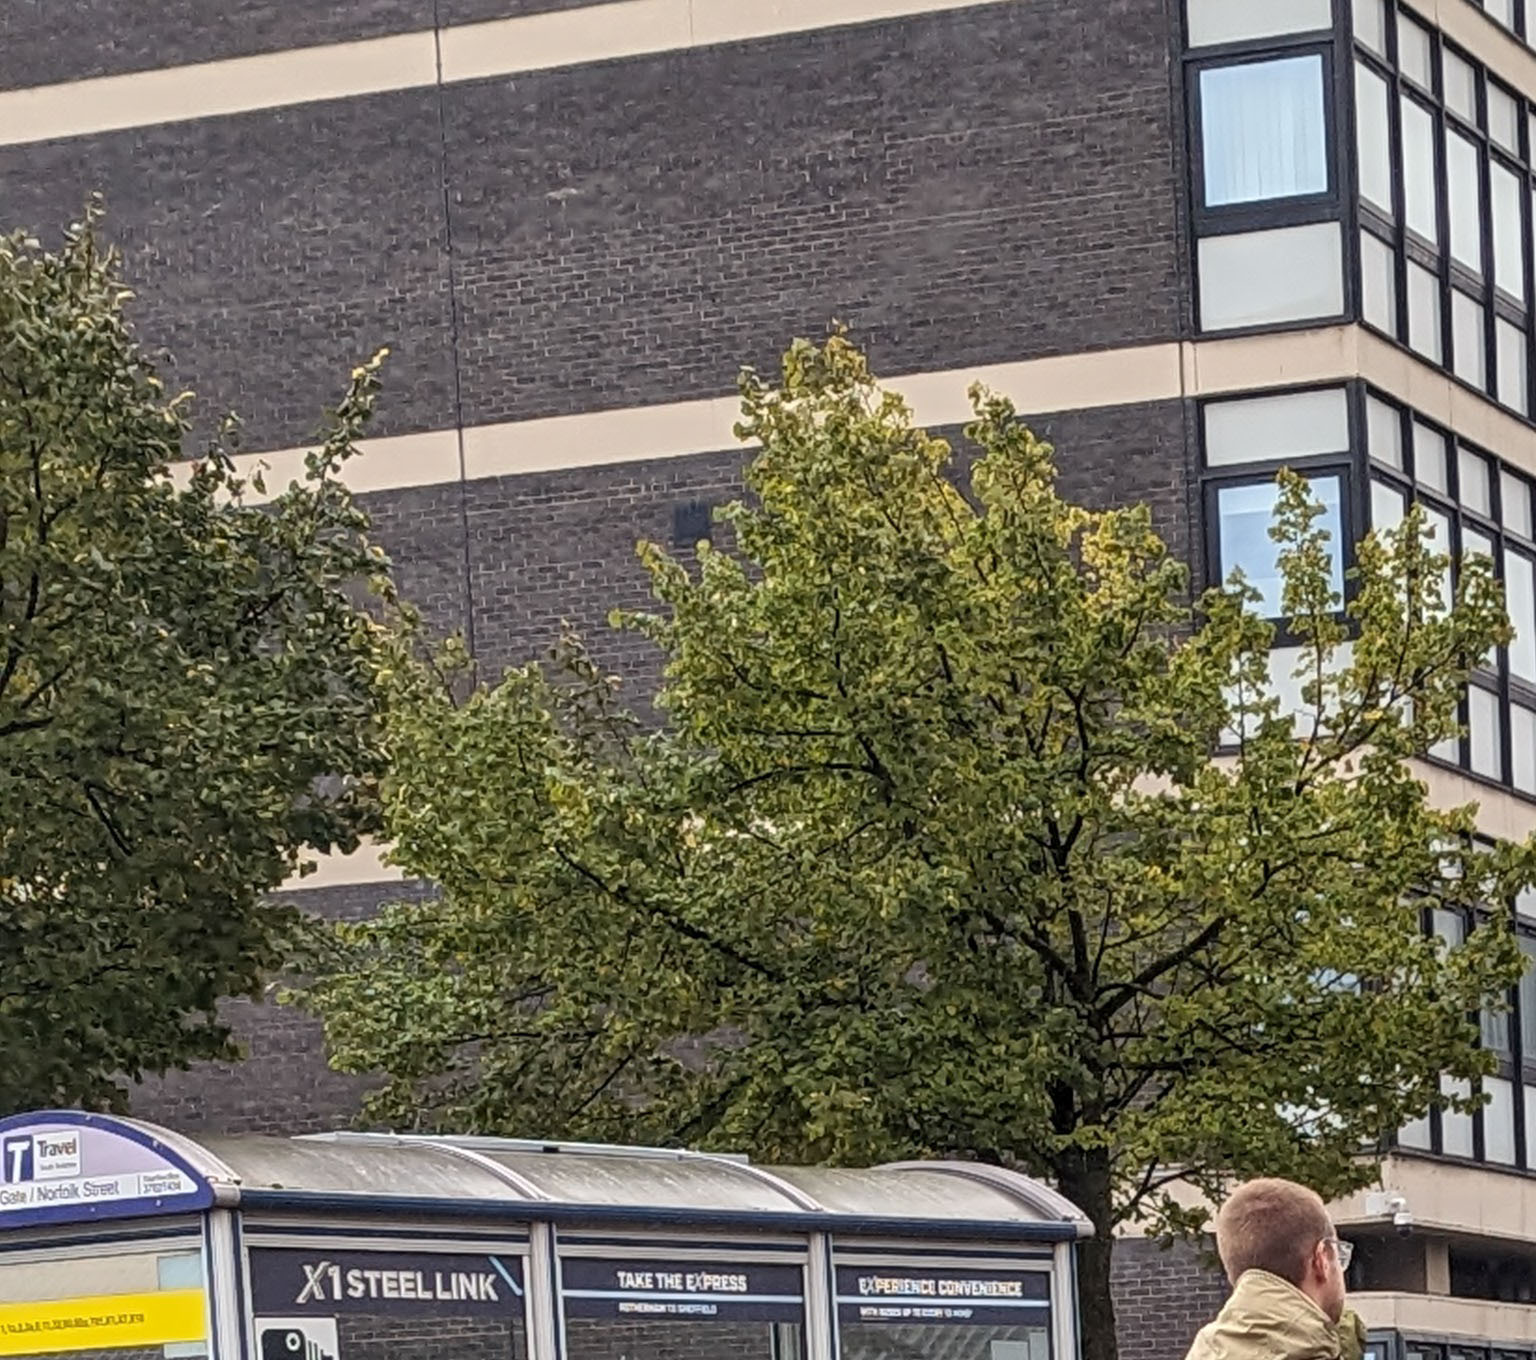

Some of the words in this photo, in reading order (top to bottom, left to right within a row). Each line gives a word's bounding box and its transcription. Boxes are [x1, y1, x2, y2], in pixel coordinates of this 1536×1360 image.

[37, 1138, 77, 1158] Travel
[0, 1190, 27, 1206] Gate
[37, 1183, 80, 1201] Norfolk
[83, 1181, 120, 1198] Street
[296, 1261, 342, 1304] X1
[346, 1269, 433, 1299] STEEL
[435, 1271, 499, 1301] LINK
[617, 1271, 654, 1289] TAKE
[655, 1272, 683, 1290] THE
[686, 1271, 748, 1292] EXPRESS
[858, 1275, 936, 1295] EXPERIENCE
[938, 1279, 1023, 1297] CONVENIENCE
